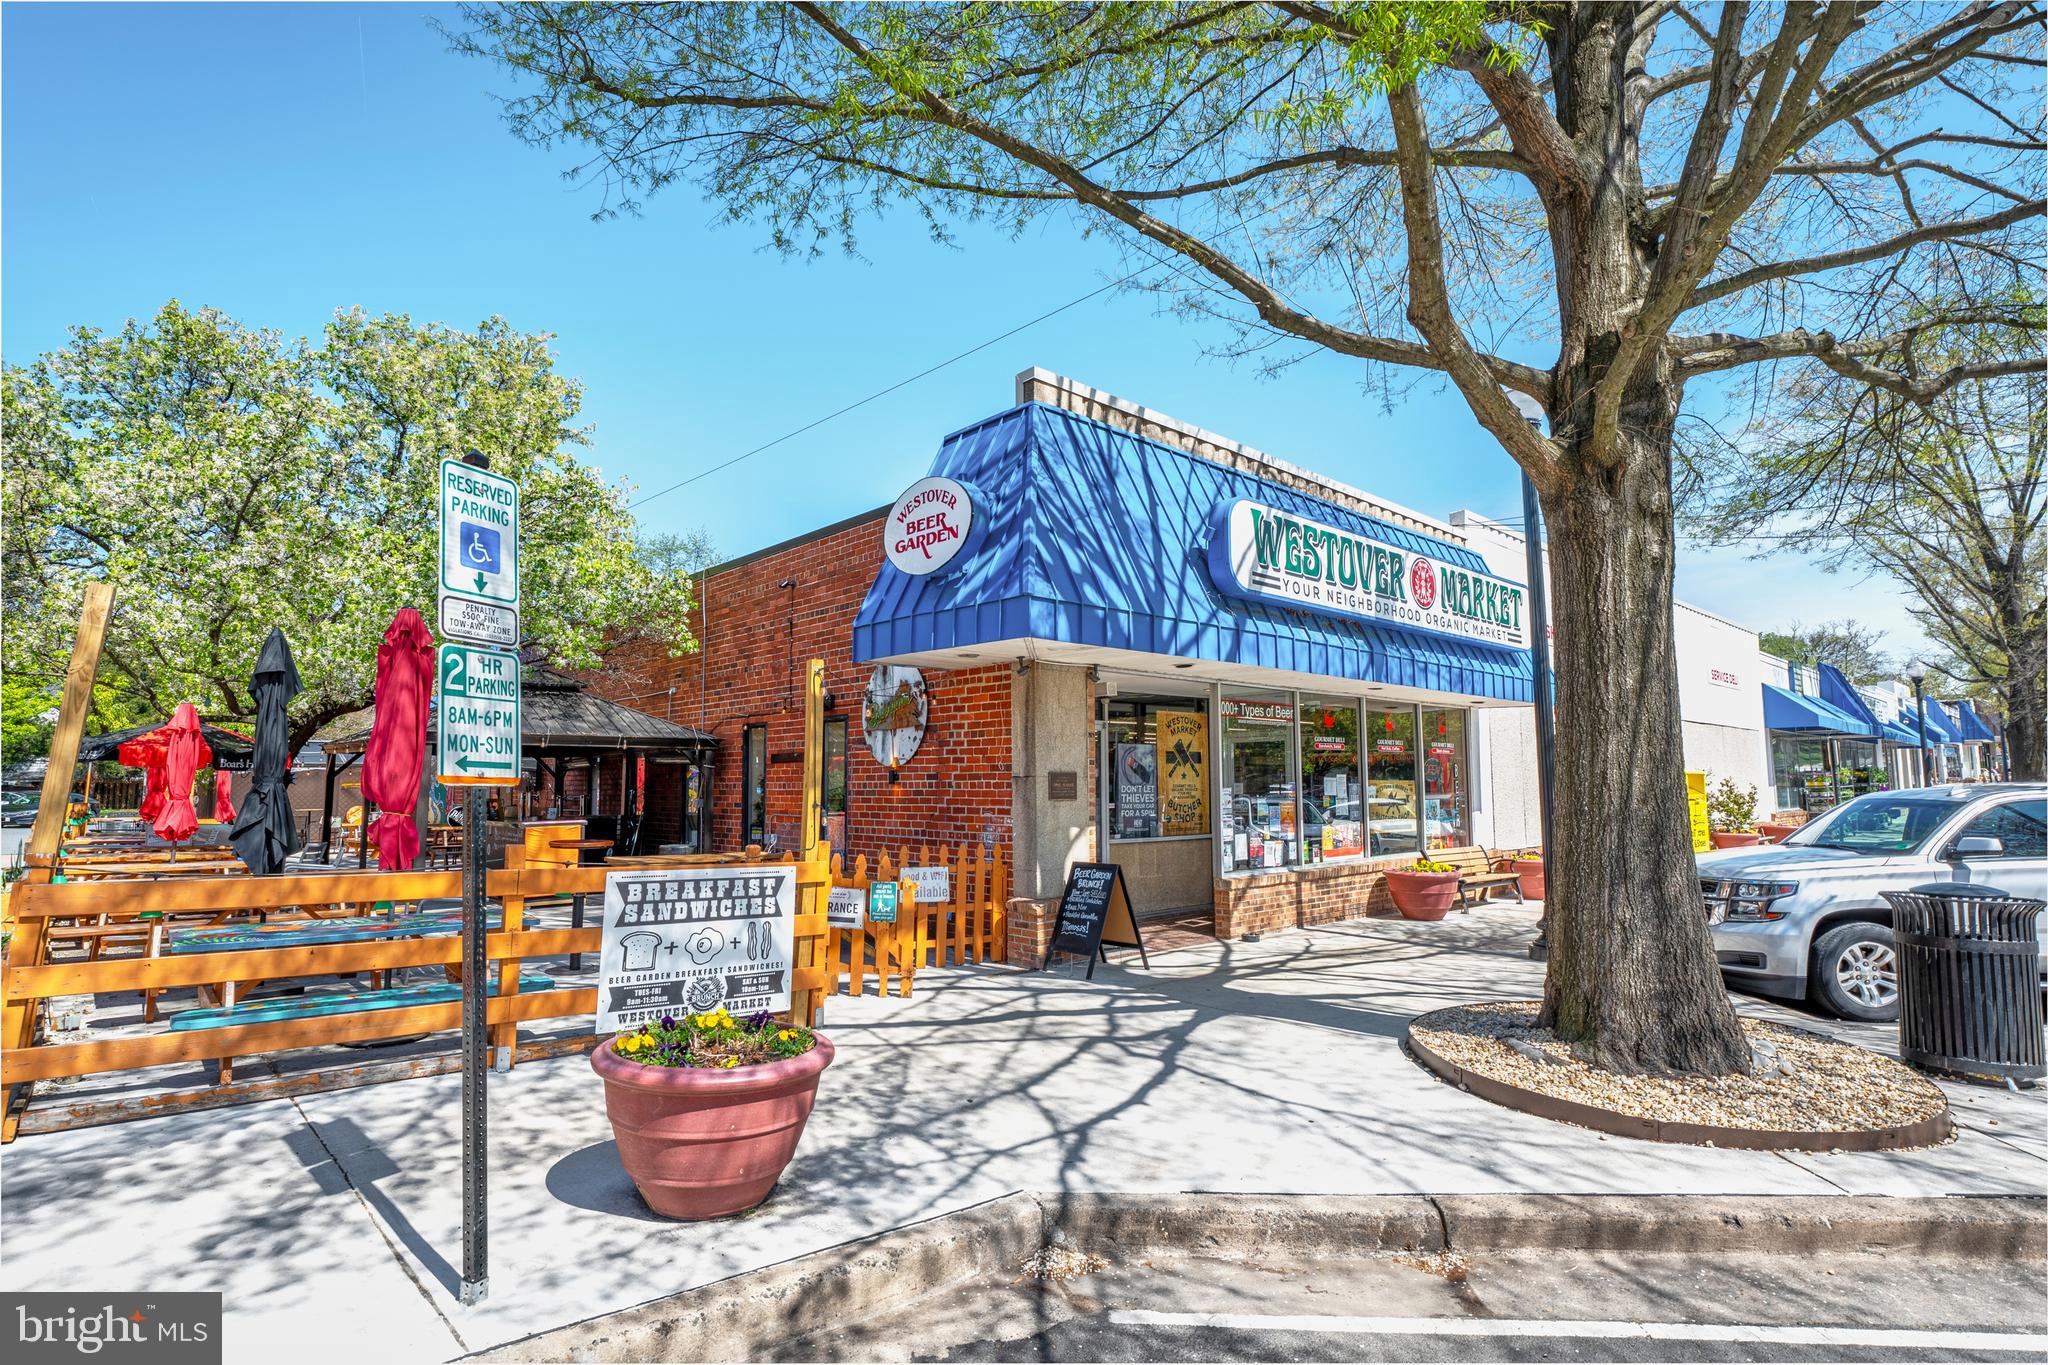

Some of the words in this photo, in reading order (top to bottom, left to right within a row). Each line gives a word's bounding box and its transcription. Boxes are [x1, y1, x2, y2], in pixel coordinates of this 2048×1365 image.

[447, 472, 512, 507] RESERVED
[451, 496, 509, 527] PARKING
[896, 489, 957, 524] WESTOVER
[906, 512, 947, 535] BEER
[894, 524, 959, 560] GARDEN
[1250, 508, 1408, 604] WESTOVER
[1440, 567, 1523, 631] MARKET
[465, 603, 496, 616] PENALTY
[1282, 578, 1320, 599] YOUR
[1326, 589, 1421, 622] NEIGHBORHOOD
[1425, 612, 1469, 633] ORGANIC
[1473, 624, 1507, 641] MARKET
[449, 617, 490, 632] TOW-AWAY
[493, 625, 511, 636] ZONE
[484, 615, 500, 625] FINE
[445, 654, 464, 691] 2
[481, 658, 503, 676] HR
[1711, 669, 1729, 683] SERVICE
[468, 674, 516, 697] PARKING
[448, 706, 513, 728] 8AM-6PM
[1221, 701, 1239, 715] 000+
[1240, 702, 1265, 718] Types
[1265, 705, 1274, 717] of
[1275, 706, 1294, 719] Beer
[1165, 716, 1202, 731] WESTOVER
[1170, 725, 1198, 737] MARKET
[447, 734, 514, 755] MON-SUN
[219, 759, 244, 768] Boar's
[1121, 785, 1142, 793] DON'T
[1143, 785, 1155, 793] LET
[1121, 794, 1155, 803] THIEVES
[1168, 799, 1202, 813] BUTCHER
[1174, 812, 1196, 823] SHOP
[922, 872, 928, 881] &
[627, 879, 776, 902] BREAKFAST
[914, 886, 948, 898] ailable
[623, 896, 776, 924] SANDWICHES
[828, 902, 859, 914] RANCE
[608, 975, 631, 985] BEER
[636, 972, 671, 982] GARDEN
[675, 967, 724, 978] BREAKFAST
[727, 961, 784, 974] SANDWICHES!
[758, 976, 769, 984] SUN
[634, 987, 662, 997] TUES-FRI
[691, 993, 721, 1002] BRUNCH
[618, 1006, 689, 1024] WESTOVER
[723, 997, 771, 1011] MARKET
